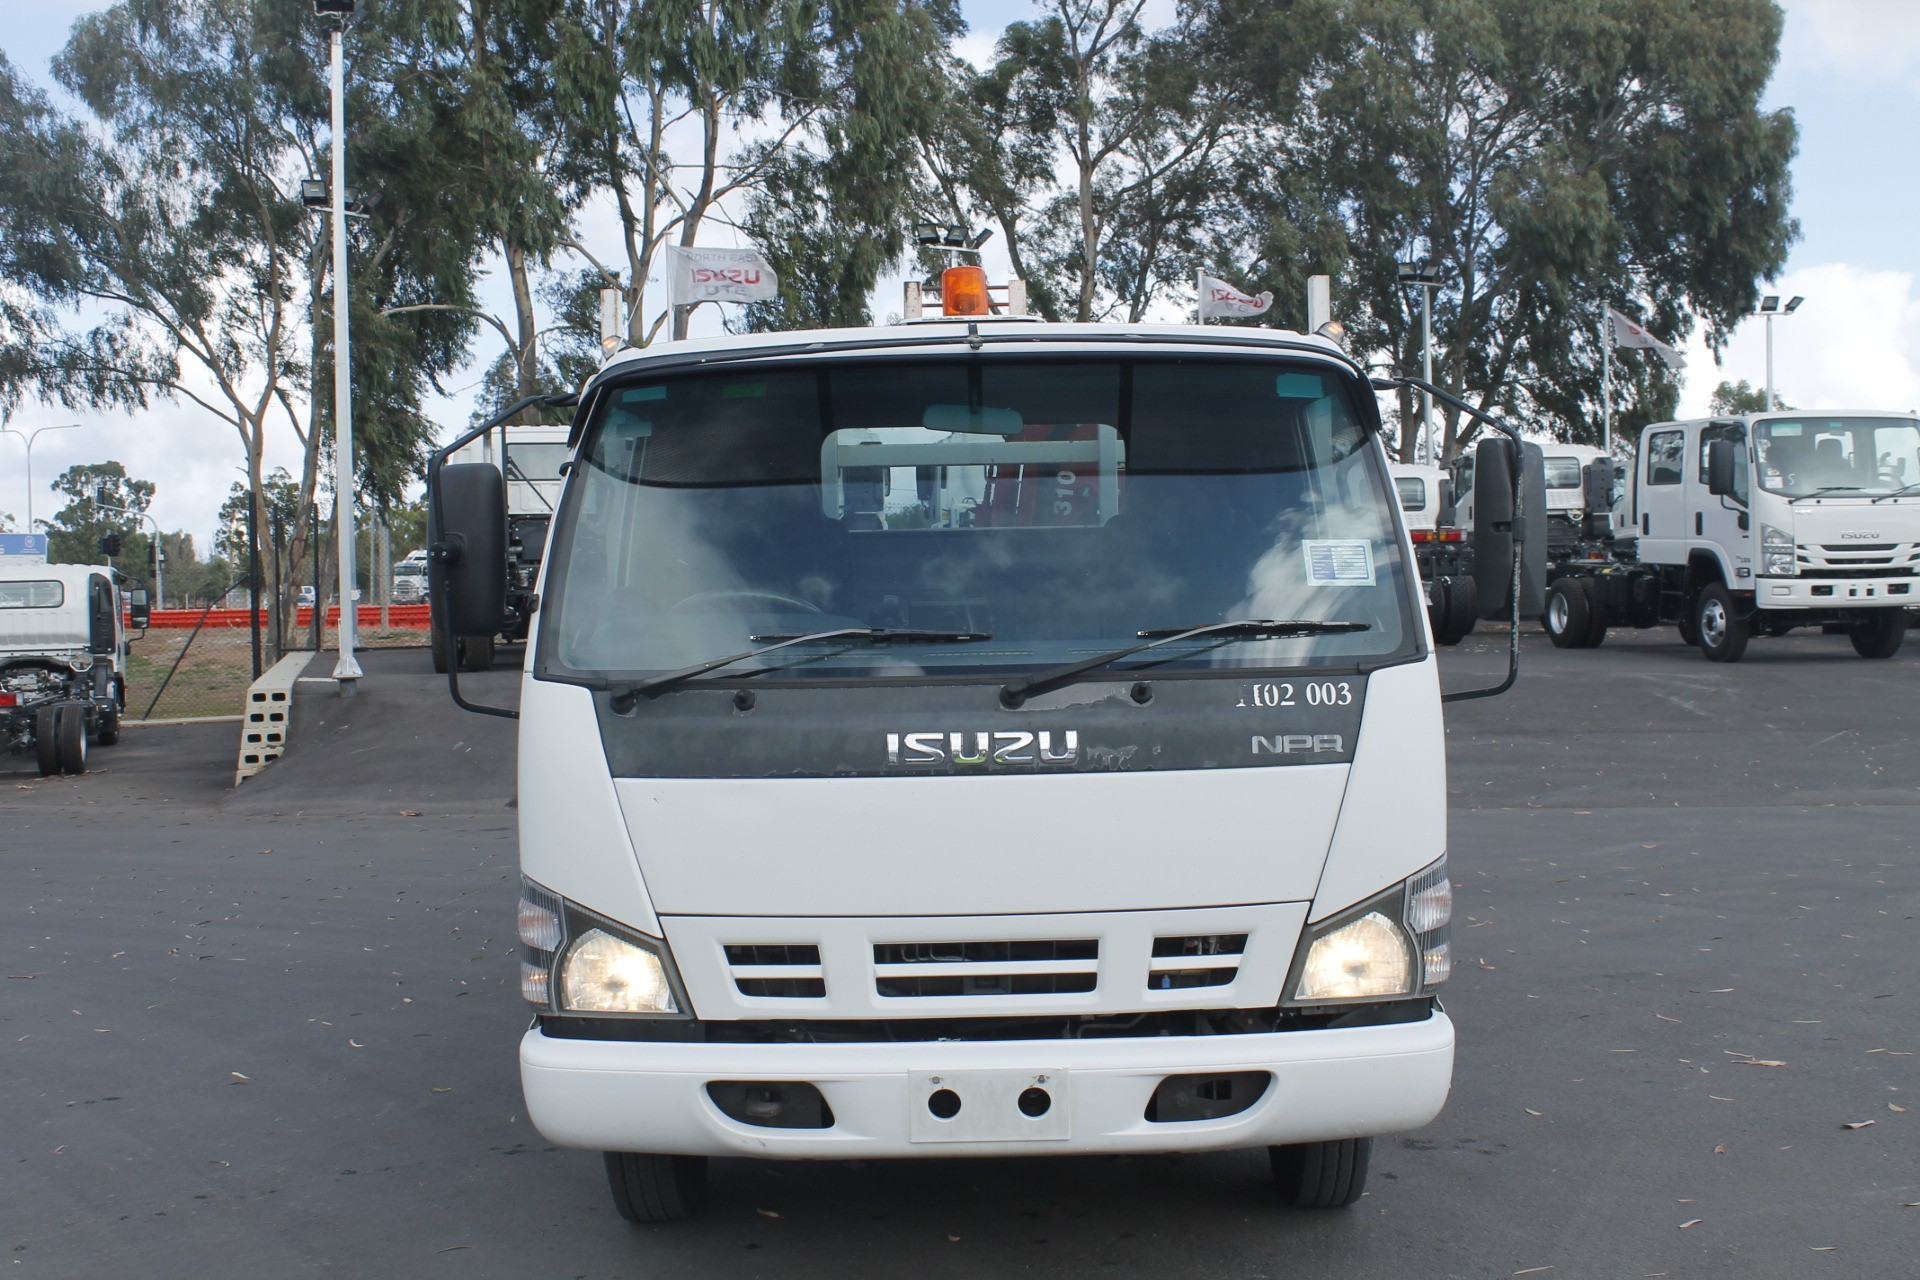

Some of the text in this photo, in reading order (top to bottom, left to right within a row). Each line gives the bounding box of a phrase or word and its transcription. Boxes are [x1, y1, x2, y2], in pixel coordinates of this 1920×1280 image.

[691, 269, 760, 284] ISUZU
[705, 285, 747, 296] UTE
[1054, 470, 1076, 516] 310
[1841, 530, 1880, 540] ISUZU
[1306, 682, 1352, 706] 003
[886, 730, 1078, 766] ISUZU
[1251, 734, 1344, 754] NPR
